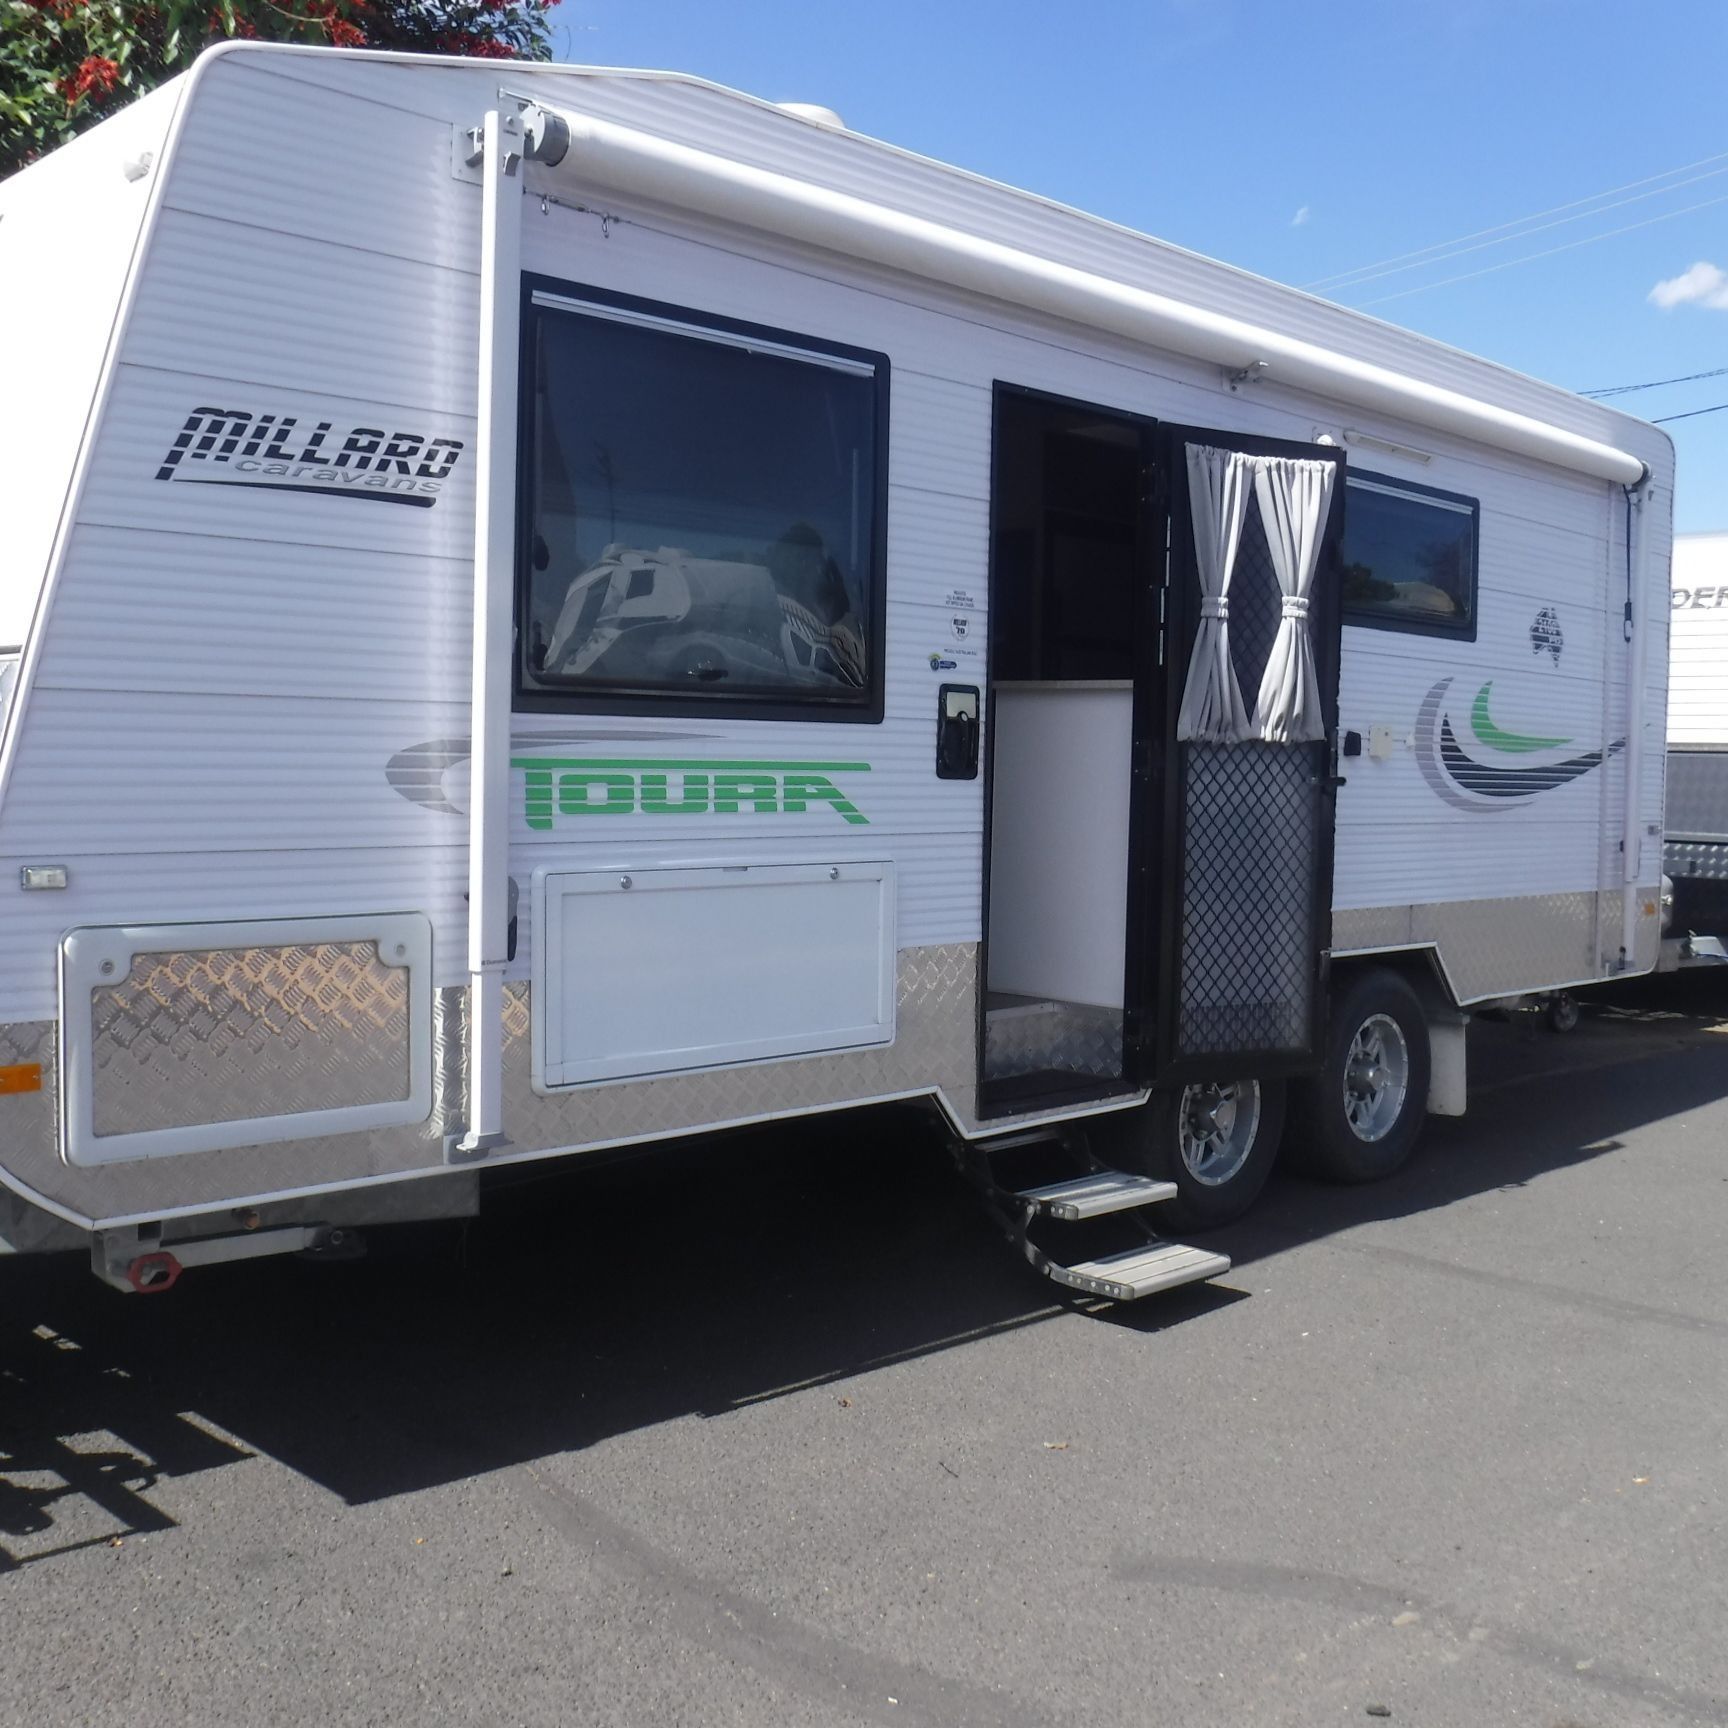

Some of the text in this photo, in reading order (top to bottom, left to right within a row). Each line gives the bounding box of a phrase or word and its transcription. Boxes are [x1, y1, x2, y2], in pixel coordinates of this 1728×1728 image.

[155, 406, 464, 481] MILLARD
[234, 457, 442, 493] caravans
[510, 757, 872, 831] TOURA
